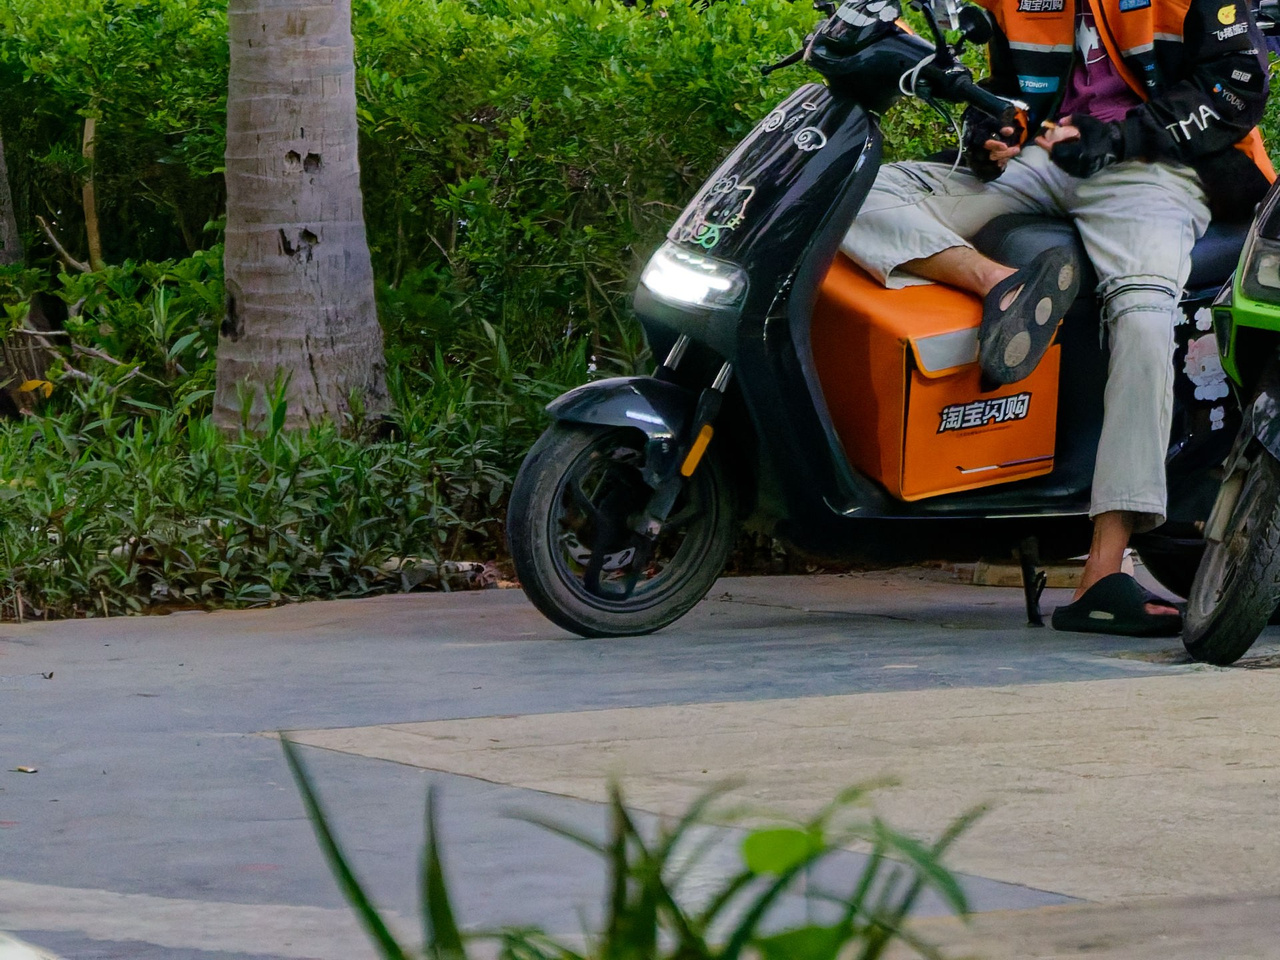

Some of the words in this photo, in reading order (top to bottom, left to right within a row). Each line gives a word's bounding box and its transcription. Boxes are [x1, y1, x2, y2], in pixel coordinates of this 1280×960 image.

[1222, 89, 1246, 111] YOUKU
[938, 392, 1031, 432] 淘宝闪购
